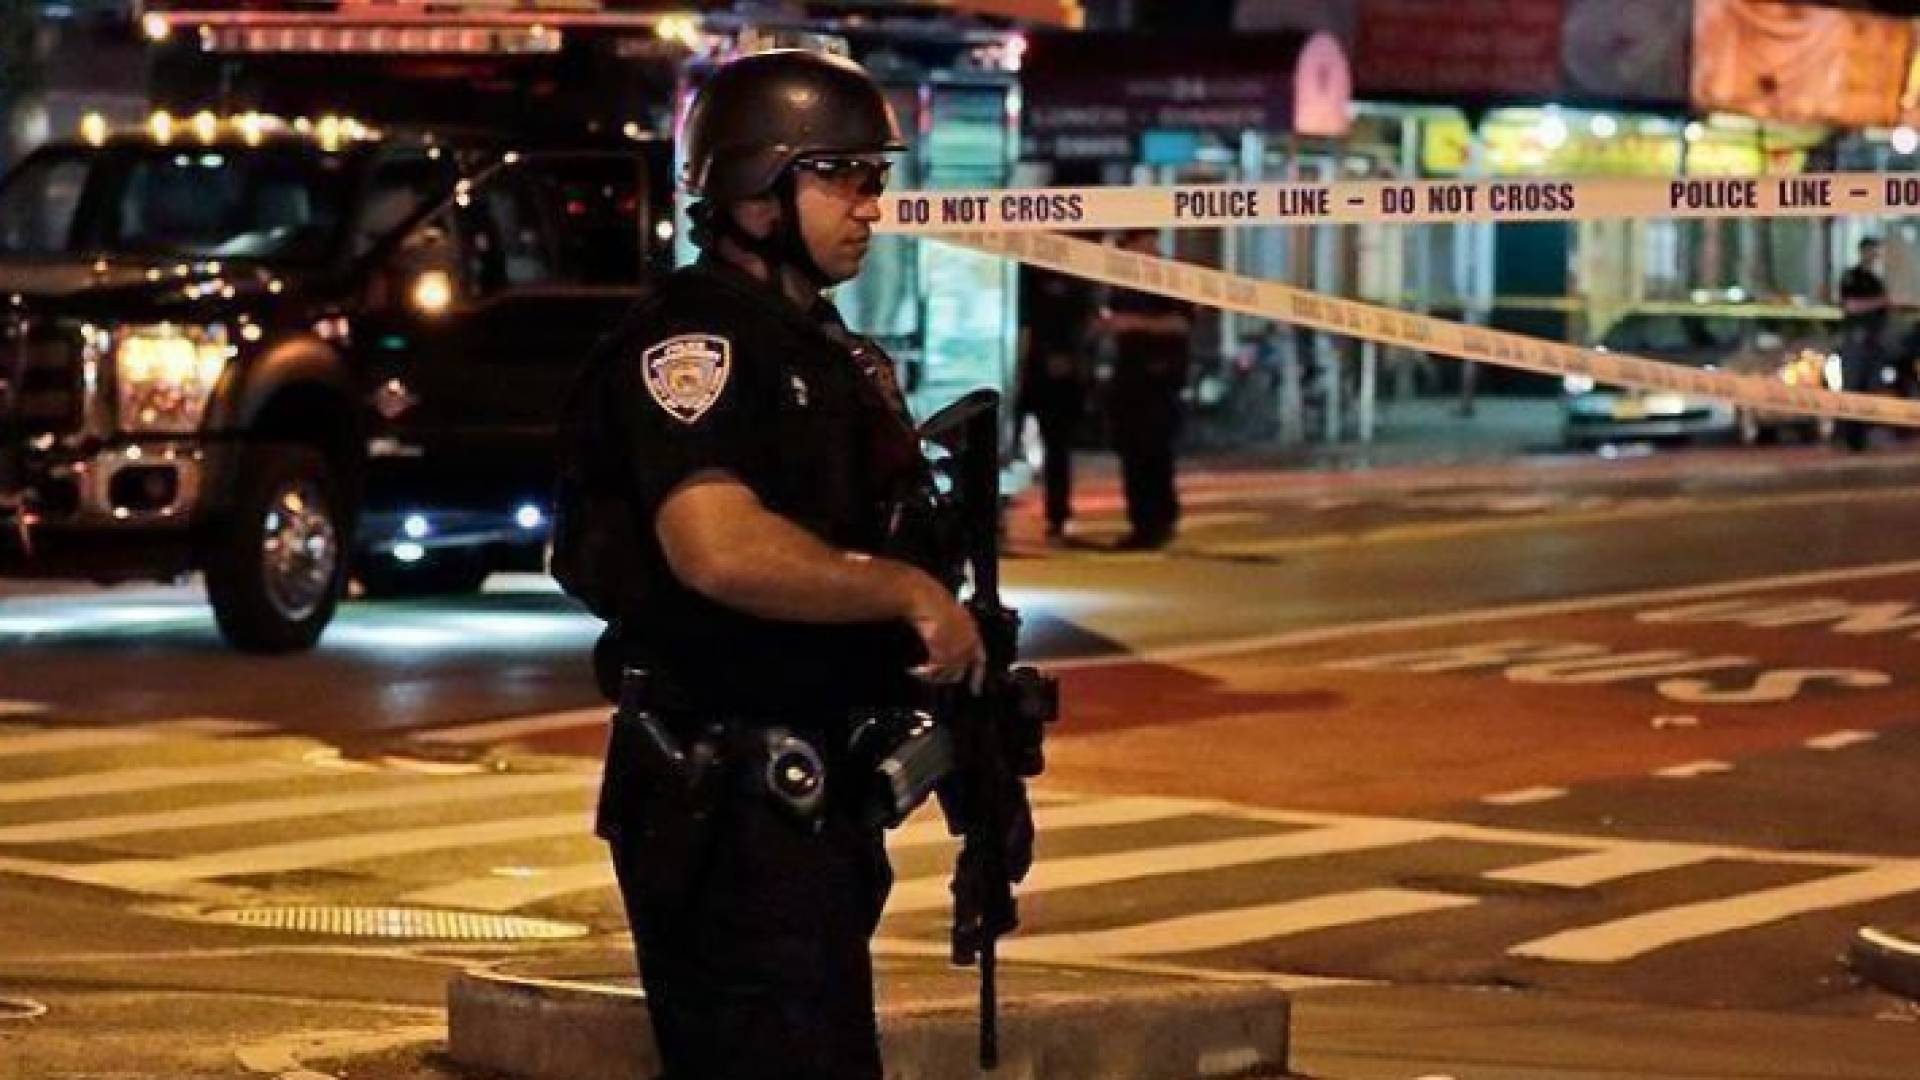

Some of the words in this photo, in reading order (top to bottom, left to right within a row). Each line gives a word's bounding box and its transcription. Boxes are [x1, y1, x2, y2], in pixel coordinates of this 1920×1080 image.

[898, 198, 930, 224] DO
[942, 196, 989, 223] NOT
[1001, 194, 1084, 222] CROSS
[1174, 190, 1259, 218] POLICE
[1279, 188, 1331, 217] LINE
[1381, 186, 1416, 214] DO
[1428, 185, 1477, 213] NOT
[1490, 182, 1575, 212] CROSS
[1670, 180, 1759, 209] POLICE
[1779, 179, 1832, 207] LINE
[1885, 178, 1920, 206] DO
